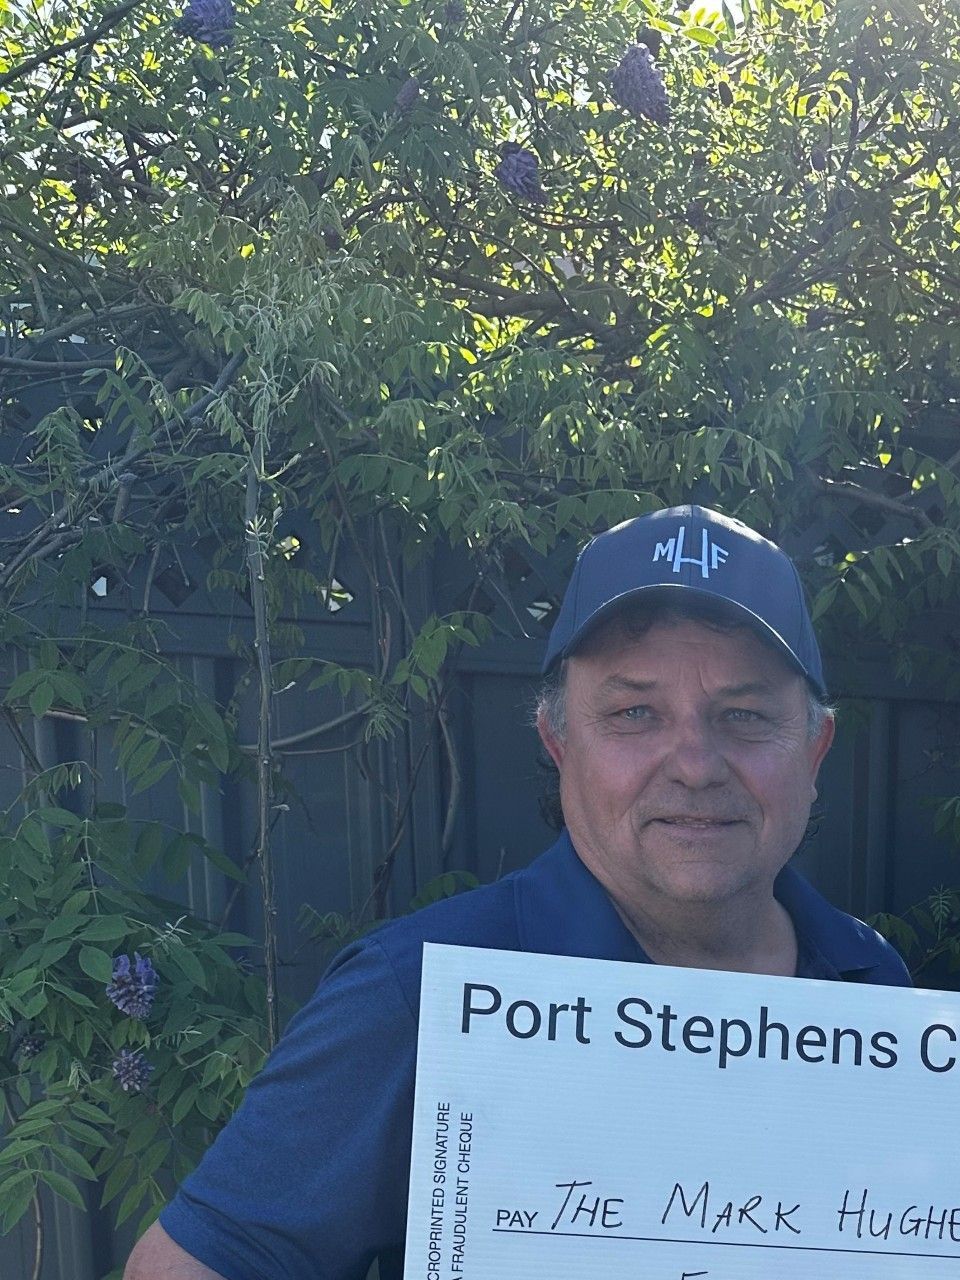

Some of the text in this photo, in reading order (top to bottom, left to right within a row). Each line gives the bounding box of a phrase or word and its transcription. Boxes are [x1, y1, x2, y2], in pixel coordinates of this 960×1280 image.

[652, 526, 729, 578] MHF
[461, 982, 592, 1044] Port
[614, 997, 898, 1069] Stephens
[433, 1101, 450, 1185] SIGNATURE
[458, 1111, 473, 1174] CHEQUE
[451, 1176, 470, 1273] FRAUDULENT
[496, 1209, 539, 1228] PAY
[551, 1180, 624, 1230] THE
[662, 1181, 801, 1233] MARK
